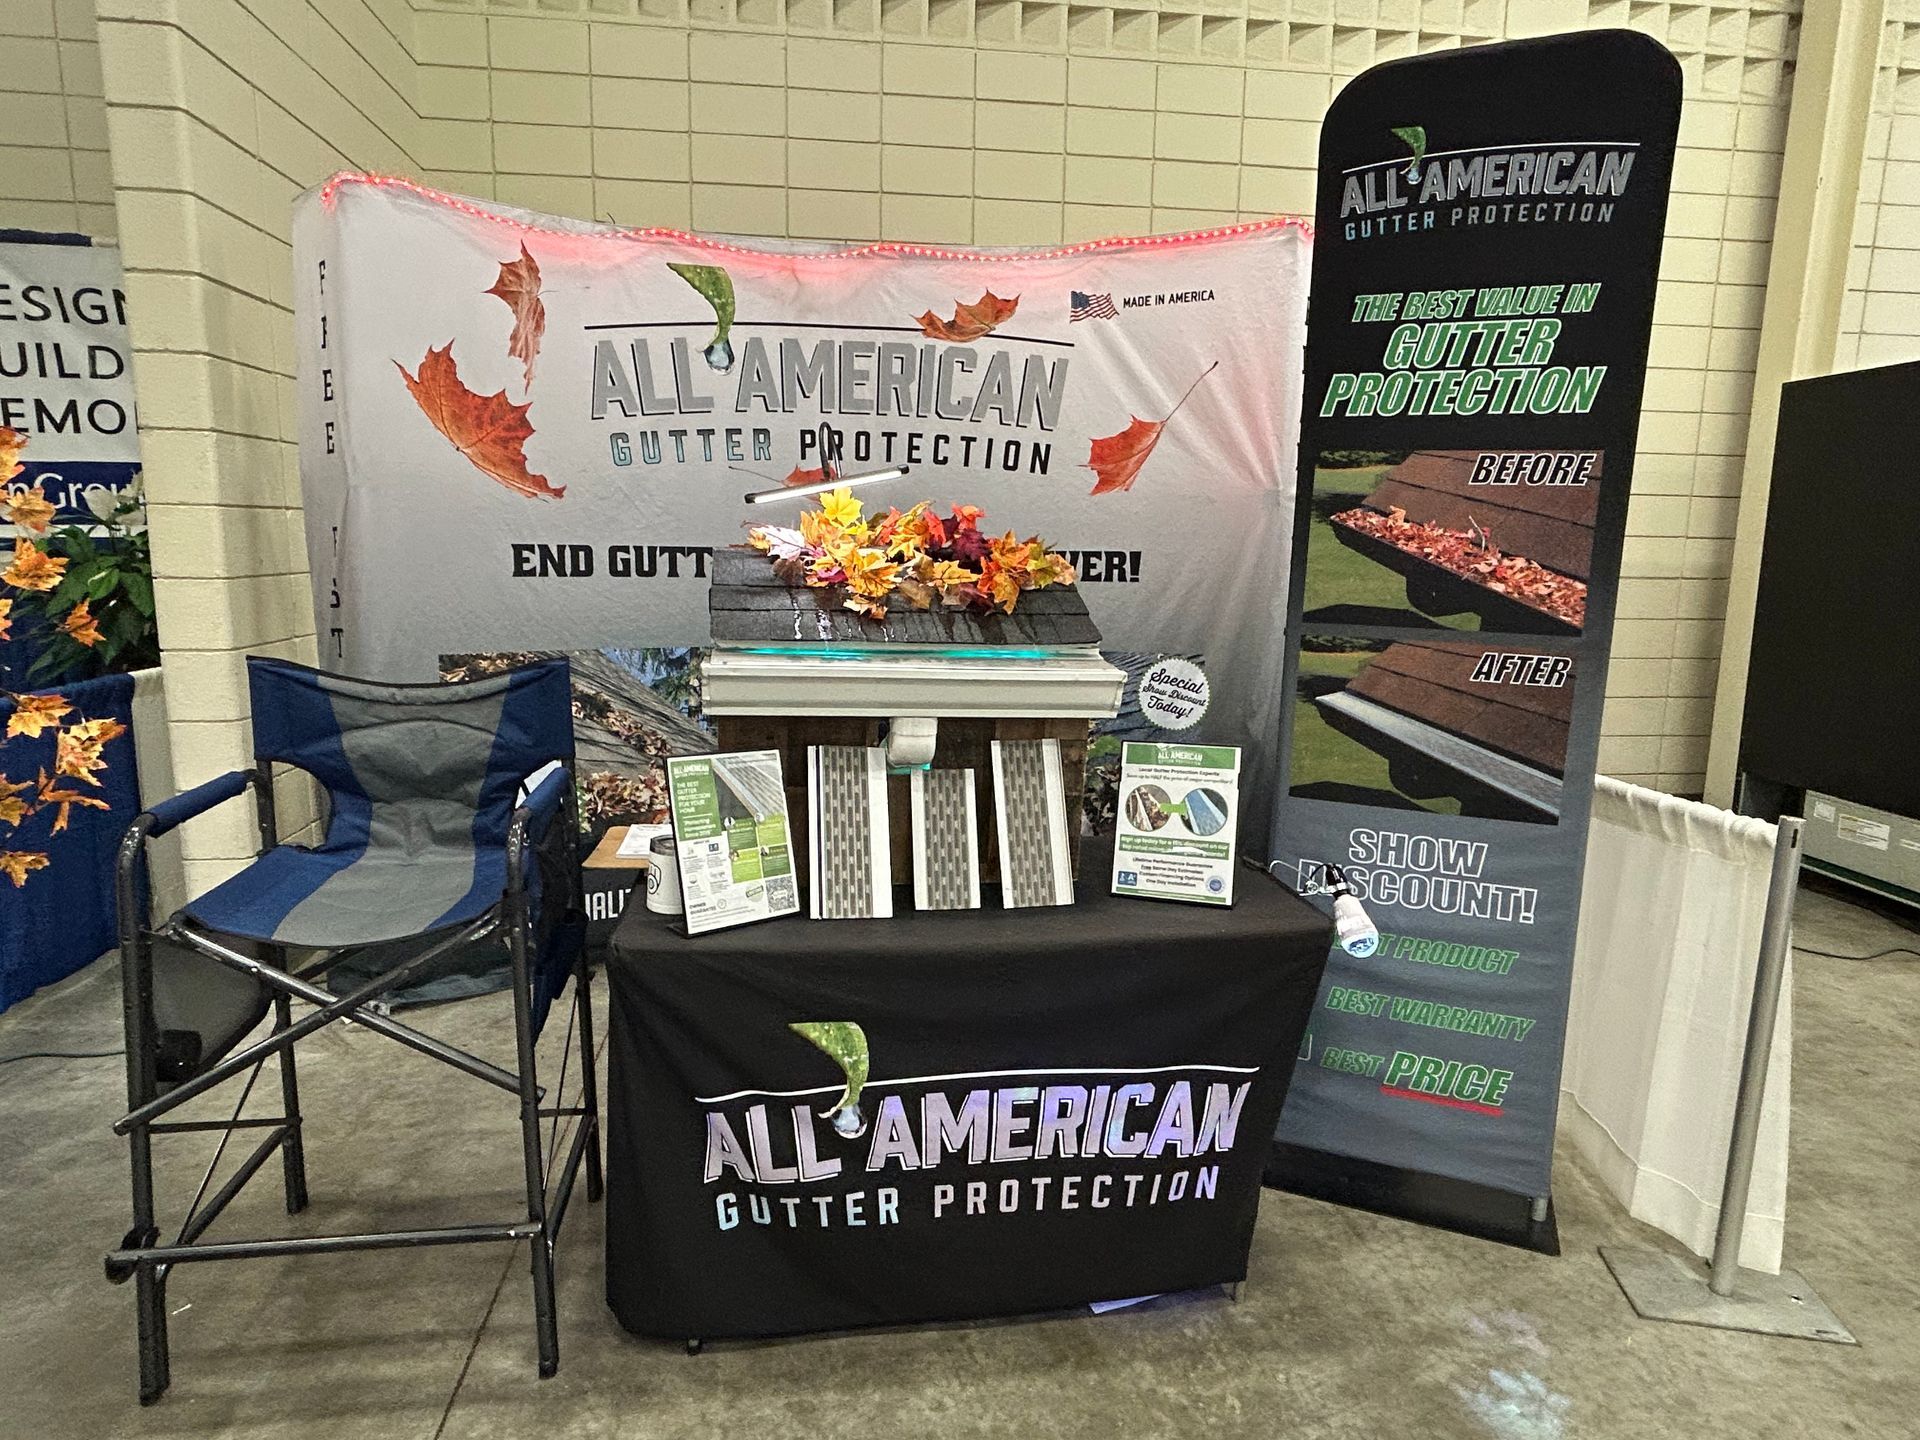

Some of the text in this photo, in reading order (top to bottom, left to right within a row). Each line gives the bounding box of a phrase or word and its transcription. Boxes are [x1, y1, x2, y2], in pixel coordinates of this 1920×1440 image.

[1340, 151, 1636, 218] ALL AMERICAN
[1345, 202, 1614, 241] GUTTER PROTECTION
[1123, 289, 1215, 308] MADE IN AMERICA
[1351, 282, 1602, 323] THE BEST VALUE IN
[0, 341, 125, 379] UILD
[1382, 319, 1562, 369] GUTTER
[591, 336, 1070, 431] ALL AMERICAN
[1319, 365, 1608, 418] PROTECTION
[0, 398, 139, 434] EMO
[611, 429, 1052, 475] GUTTER PROTECTION
[1468, 453, 1597, 487] BEFORE
[511, 543, 594, 577] END
[608, 545, 713, 577] GUTT
[1149, 668, 1204, 694] Special
[1469, 652, 1572, 688] AFTER
[1142, 683, 1206, 706] Show Discount
[1147, 695, 1194, 719] Today!
[1349, 828, 1488, 878] SHOW
[1297, 858, 1538, 925] DSCOUNT!
[1393, 936, 1520, 975] PRODUCT
[1325, 986, 1536, 1042] BEST WARRANTY
[1320, 1046, 1514, 1106] BEST PRICE
[703, 1080, 1252, 1184] ALL AMERICAN
[716, 1165, 1219, 1232] GUTTER PROTECTION
